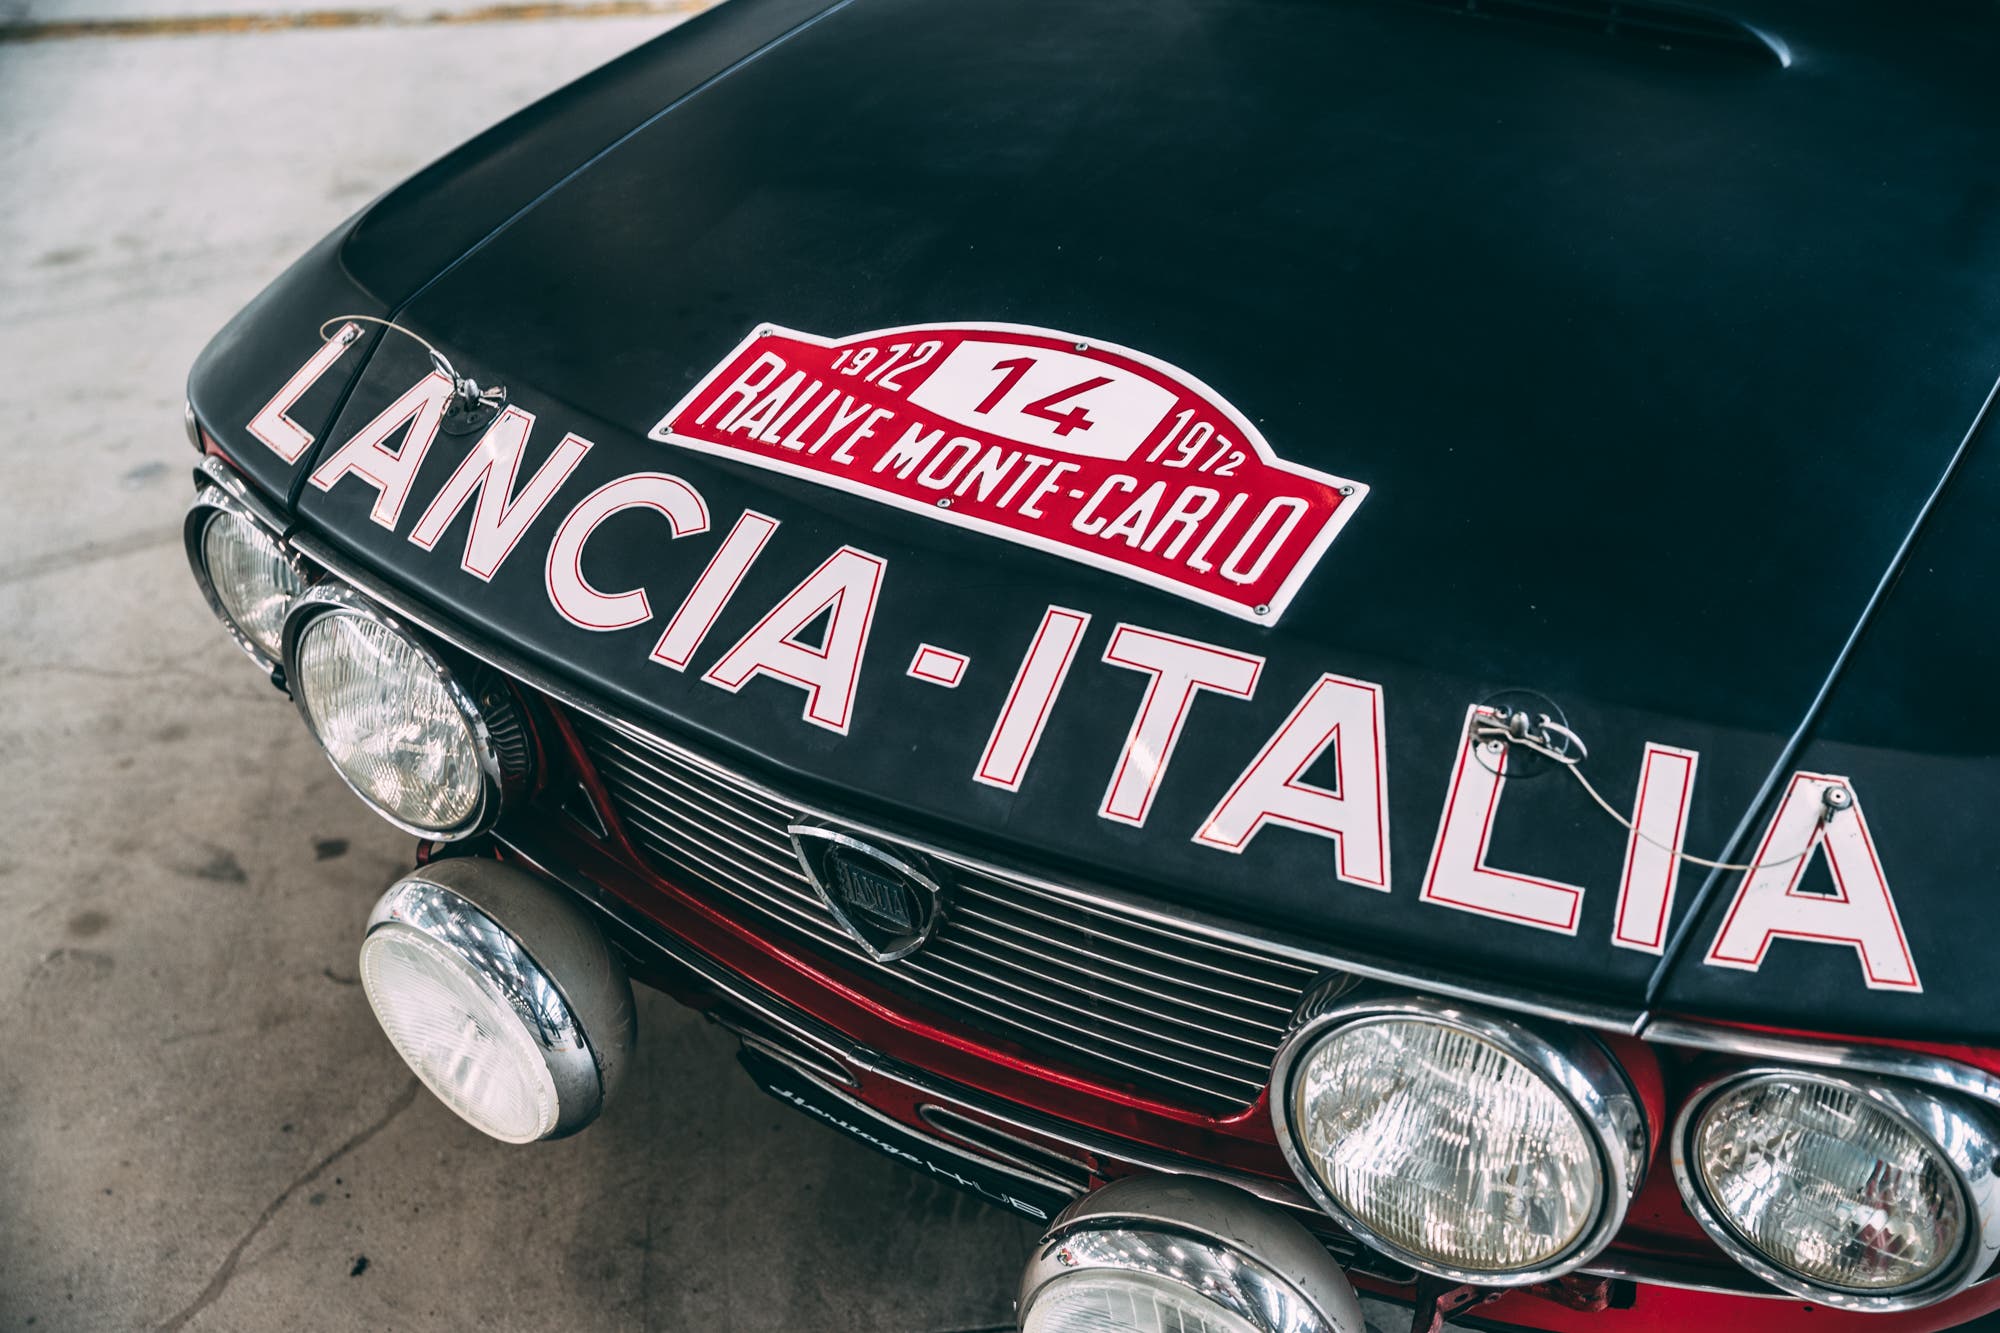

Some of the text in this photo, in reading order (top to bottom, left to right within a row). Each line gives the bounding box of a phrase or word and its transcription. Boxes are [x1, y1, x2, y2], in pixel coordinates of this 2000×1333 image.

[830, 340, 944, 392] 1972
[973, 356, 1117, 439] 14
[695, 350, 1310, 586] RALLYE MONTE-CARLO
[1146, 408, 1247, 478] 1972
